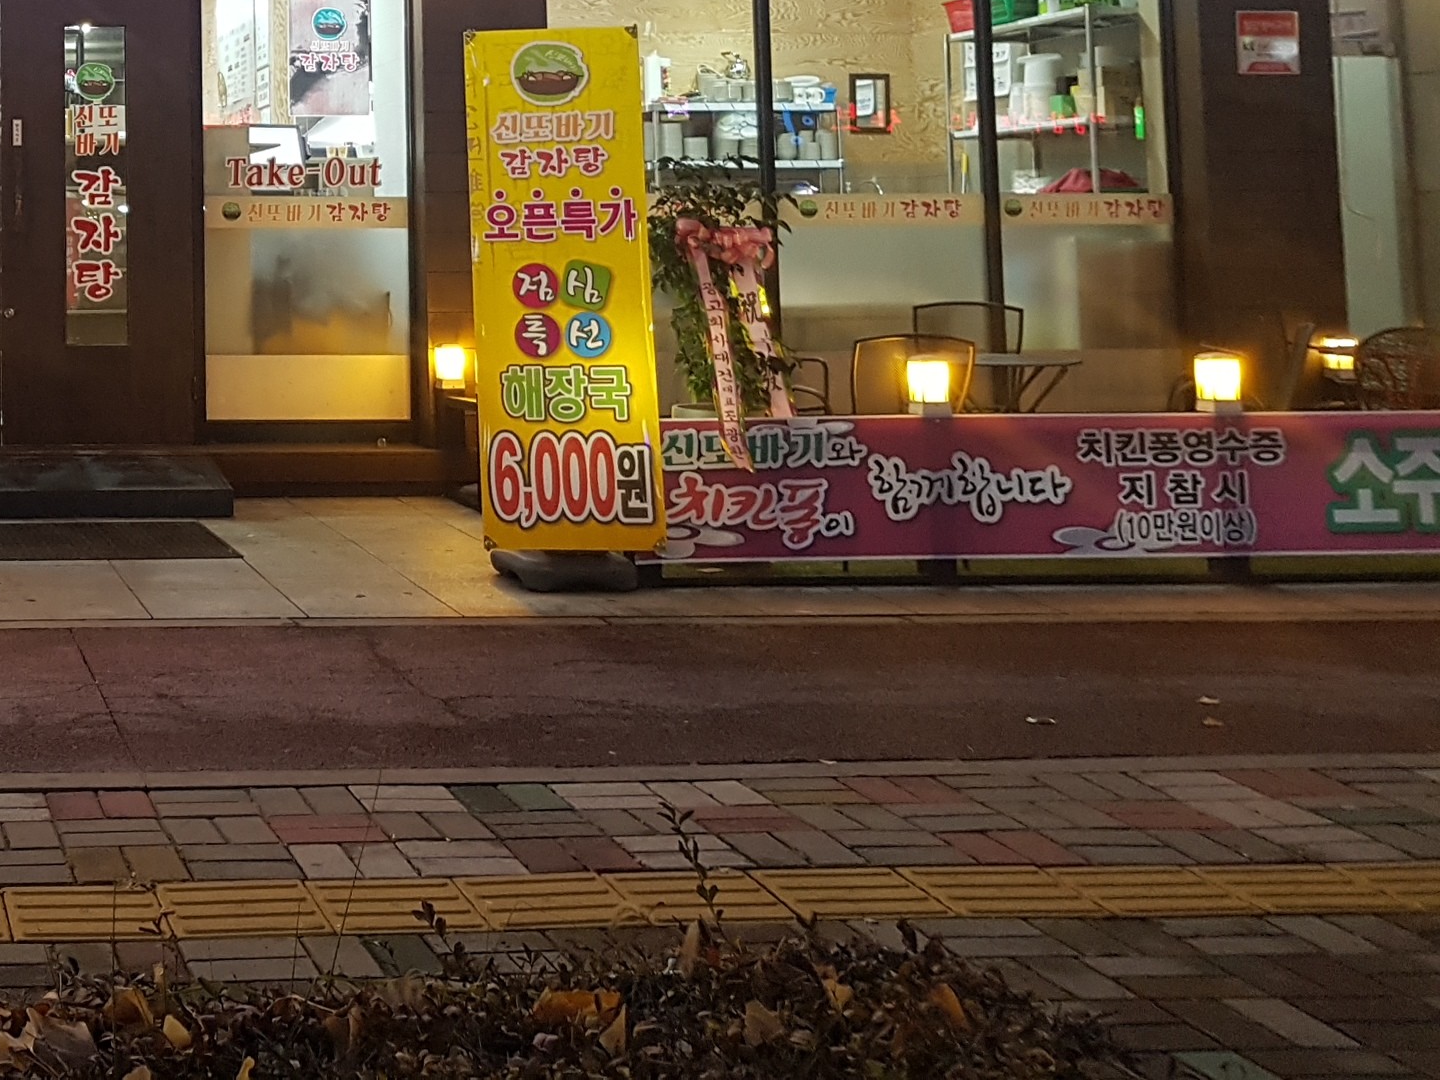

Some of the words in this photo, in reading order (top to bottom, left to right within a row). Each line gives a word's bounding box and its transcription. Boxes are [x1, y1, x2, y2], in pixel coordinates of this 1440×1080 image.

[299, 52, 361, 72] 감자탕
[491, 110, 615, 144] 신또바기
[226, 156, 382, 190] Take-Out
[499, 145, 608, 178] 감자탕
[326, 202, 391, 222] 감자탕
[483, 195, 639, 241] 오픈특가
[517, 266, 603, 303] 점심
[521, 314, 605, 356] 특선
[502, 366, 631, 420] 해장국
[1078, 428, 1285, 464] 치킨퐁영수증
[490, 432, 653, 528] 6,000원
[868, 454, 1071, 522] 함께합니다
[1115, 510, 1257, 545] (10만원이상)
